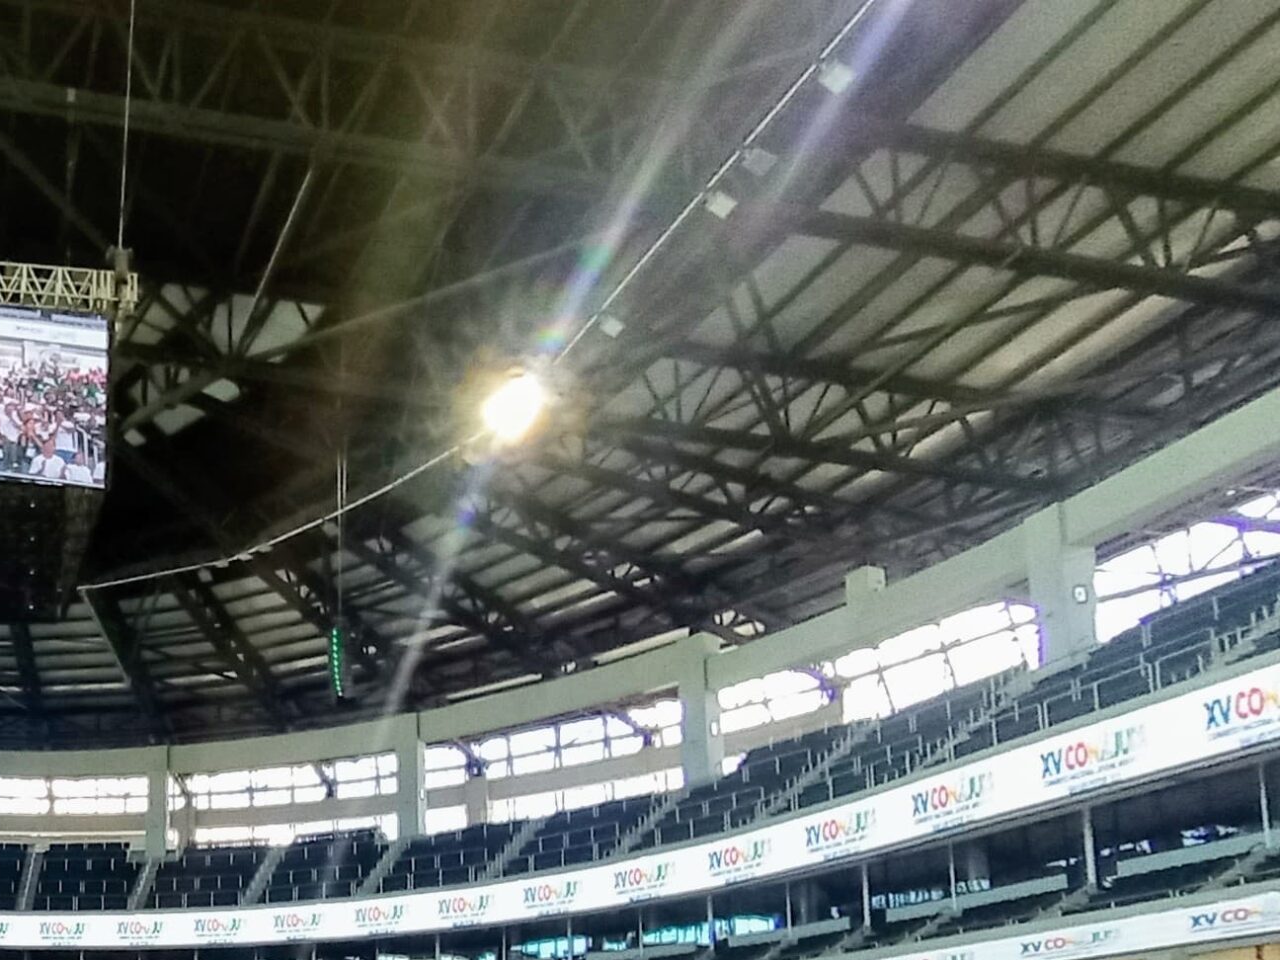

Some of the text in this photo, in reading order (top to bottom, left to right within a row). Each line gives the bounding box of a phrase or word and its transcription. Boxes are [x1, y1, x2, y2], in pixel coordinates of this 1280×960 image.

[1203, 694, 1231, 731] XV
[1040, 749, 1063, 779] XV
[912, 790, 929, 817] XV
[805, 825, 820, 848] XV
[708, 850, 723, 871] XV
[614, 871, 628, 889] XV
[523, 887, 538, 903] XV
[438, 898, 452, 914] XV
[273, 914, 286, 928] XV
[354, 908, 368, 922] XV
[39, 922, 51, 934] XV
[116, 921, 129, 934] XV
[193, 918, 207, 933] XV
